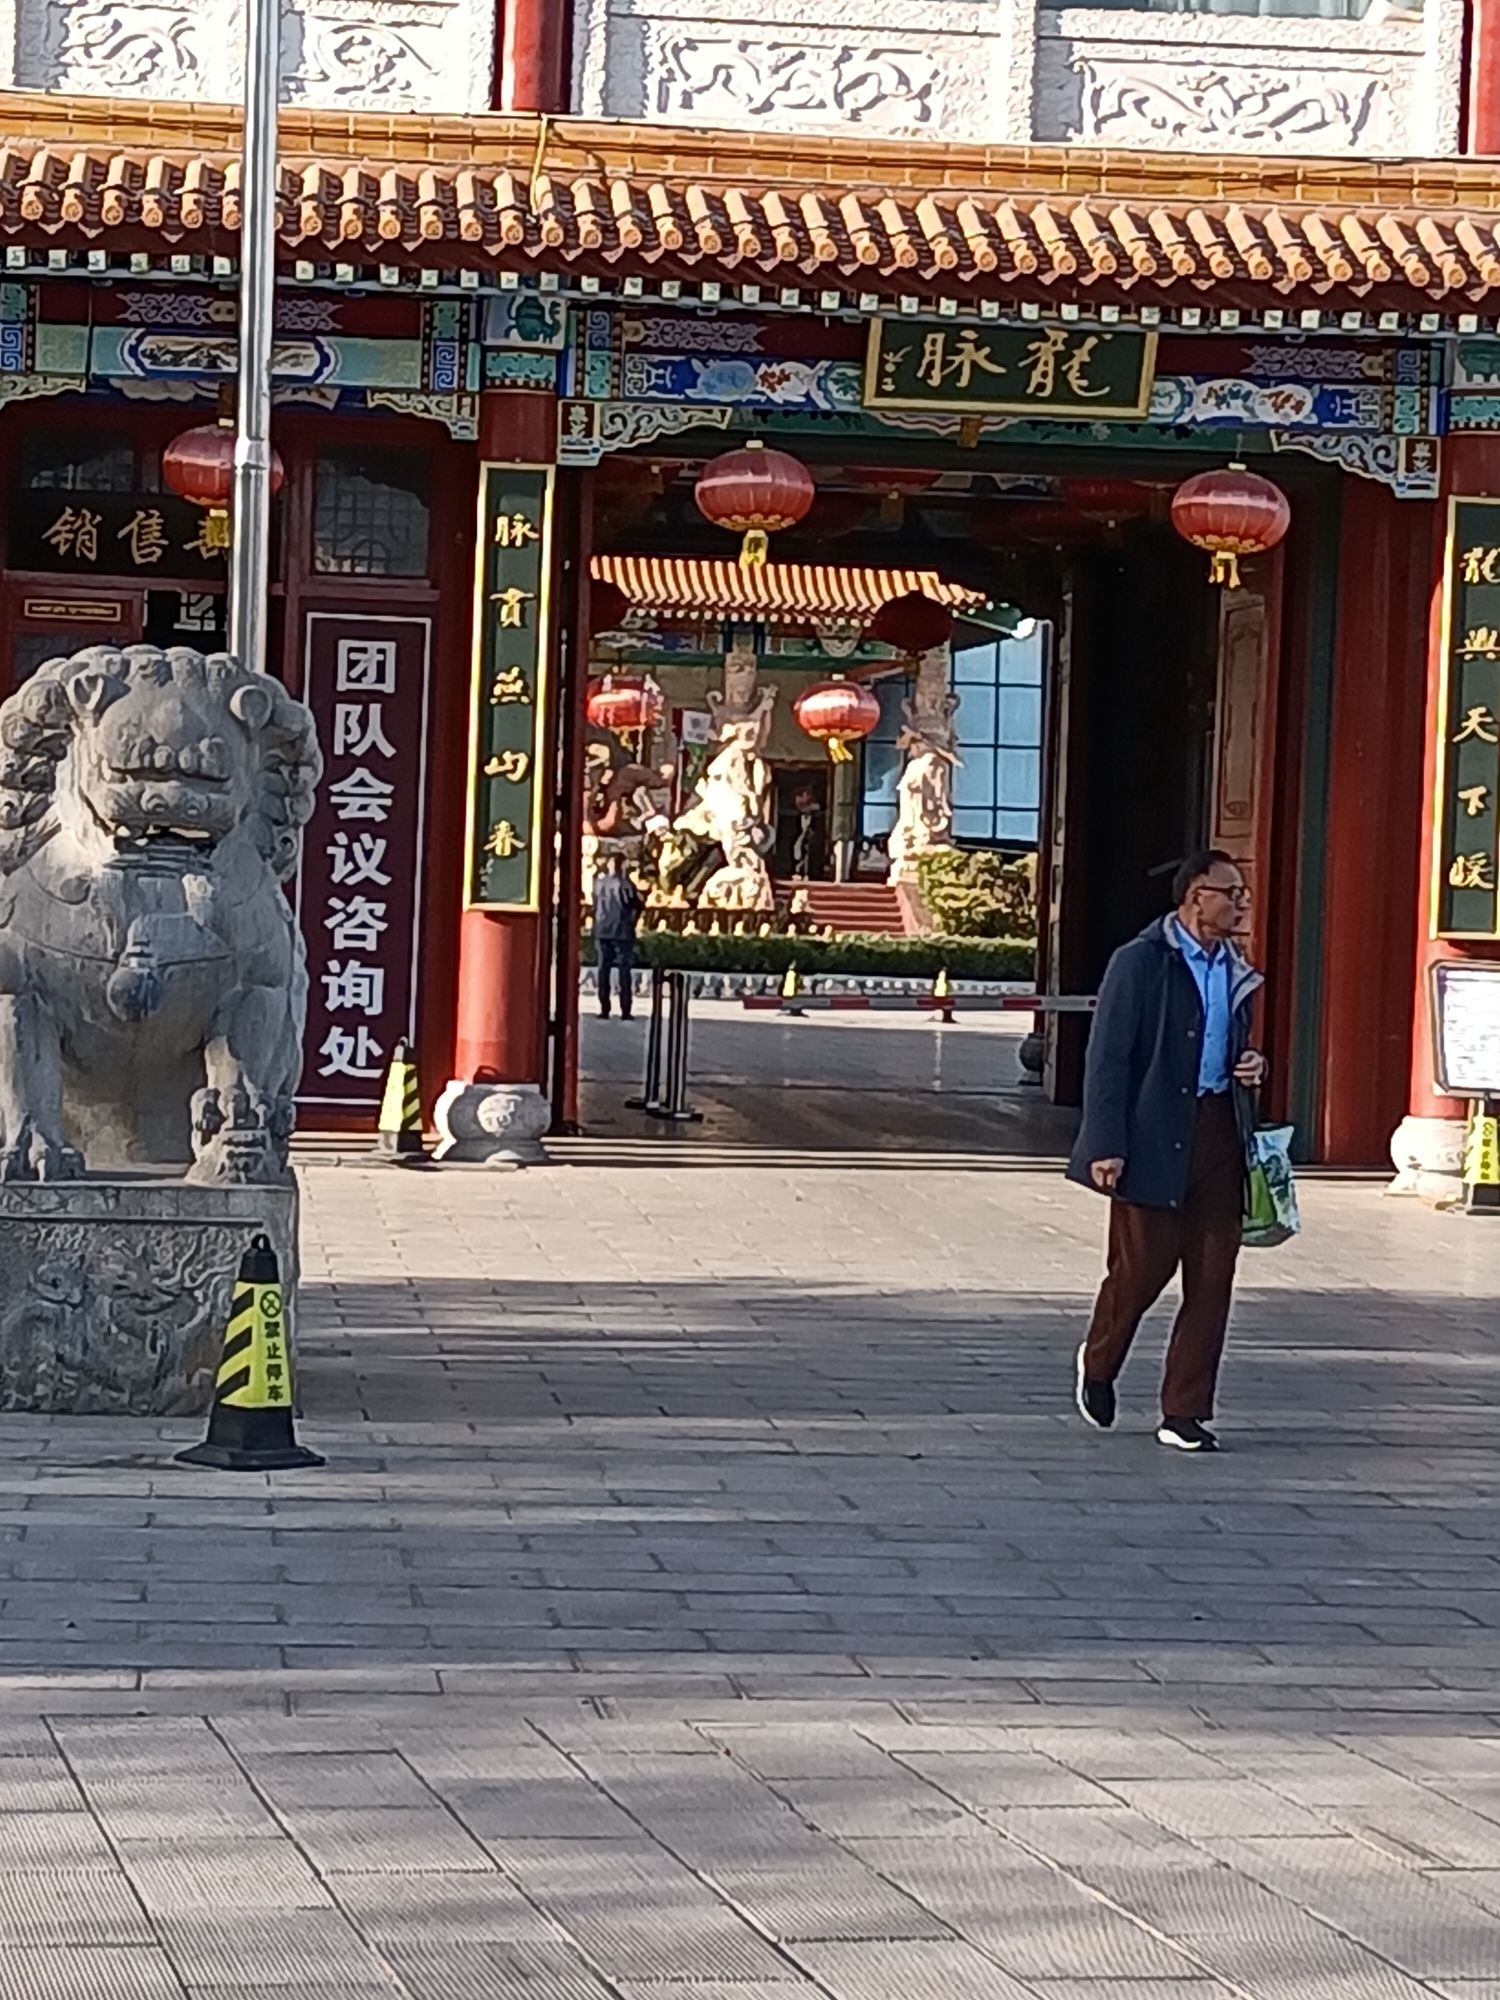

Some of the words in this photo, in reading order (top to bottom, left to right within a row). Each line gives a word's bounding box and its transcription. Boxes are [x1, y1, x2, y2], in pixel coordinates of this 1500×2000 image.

[318, 639, 397, 1079] 团队会议咨询处
[264, 1321, 284, 1402] 禁止停车
